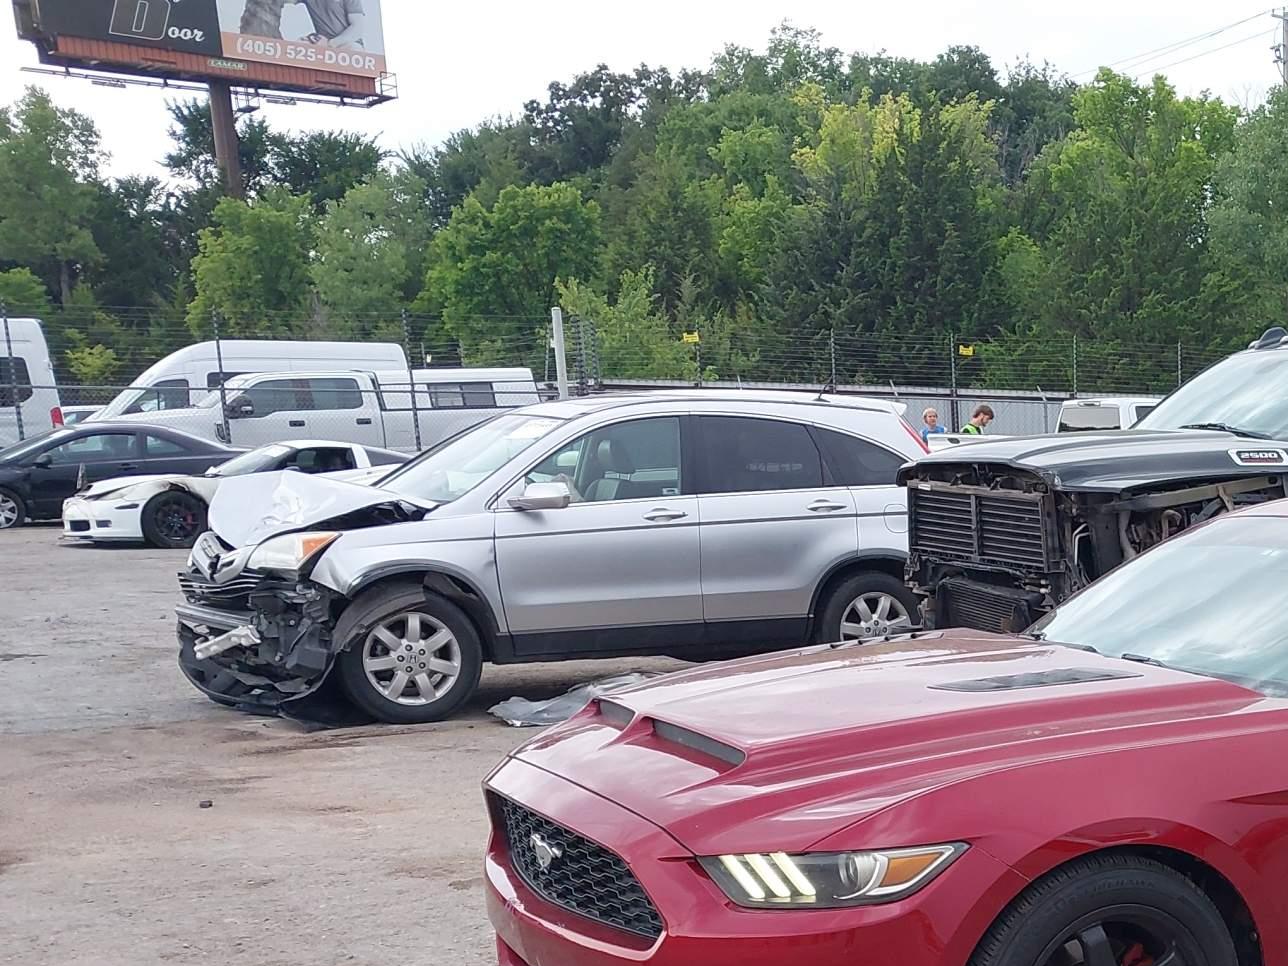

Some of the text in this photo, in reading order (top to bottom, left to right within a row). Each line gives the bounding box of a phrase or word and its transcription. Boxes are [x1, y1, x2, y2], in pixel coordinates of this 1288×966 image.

[236, 39, 376, 71] (405) 525-DOOR
[1240, 452, 1279, 460] 2500
